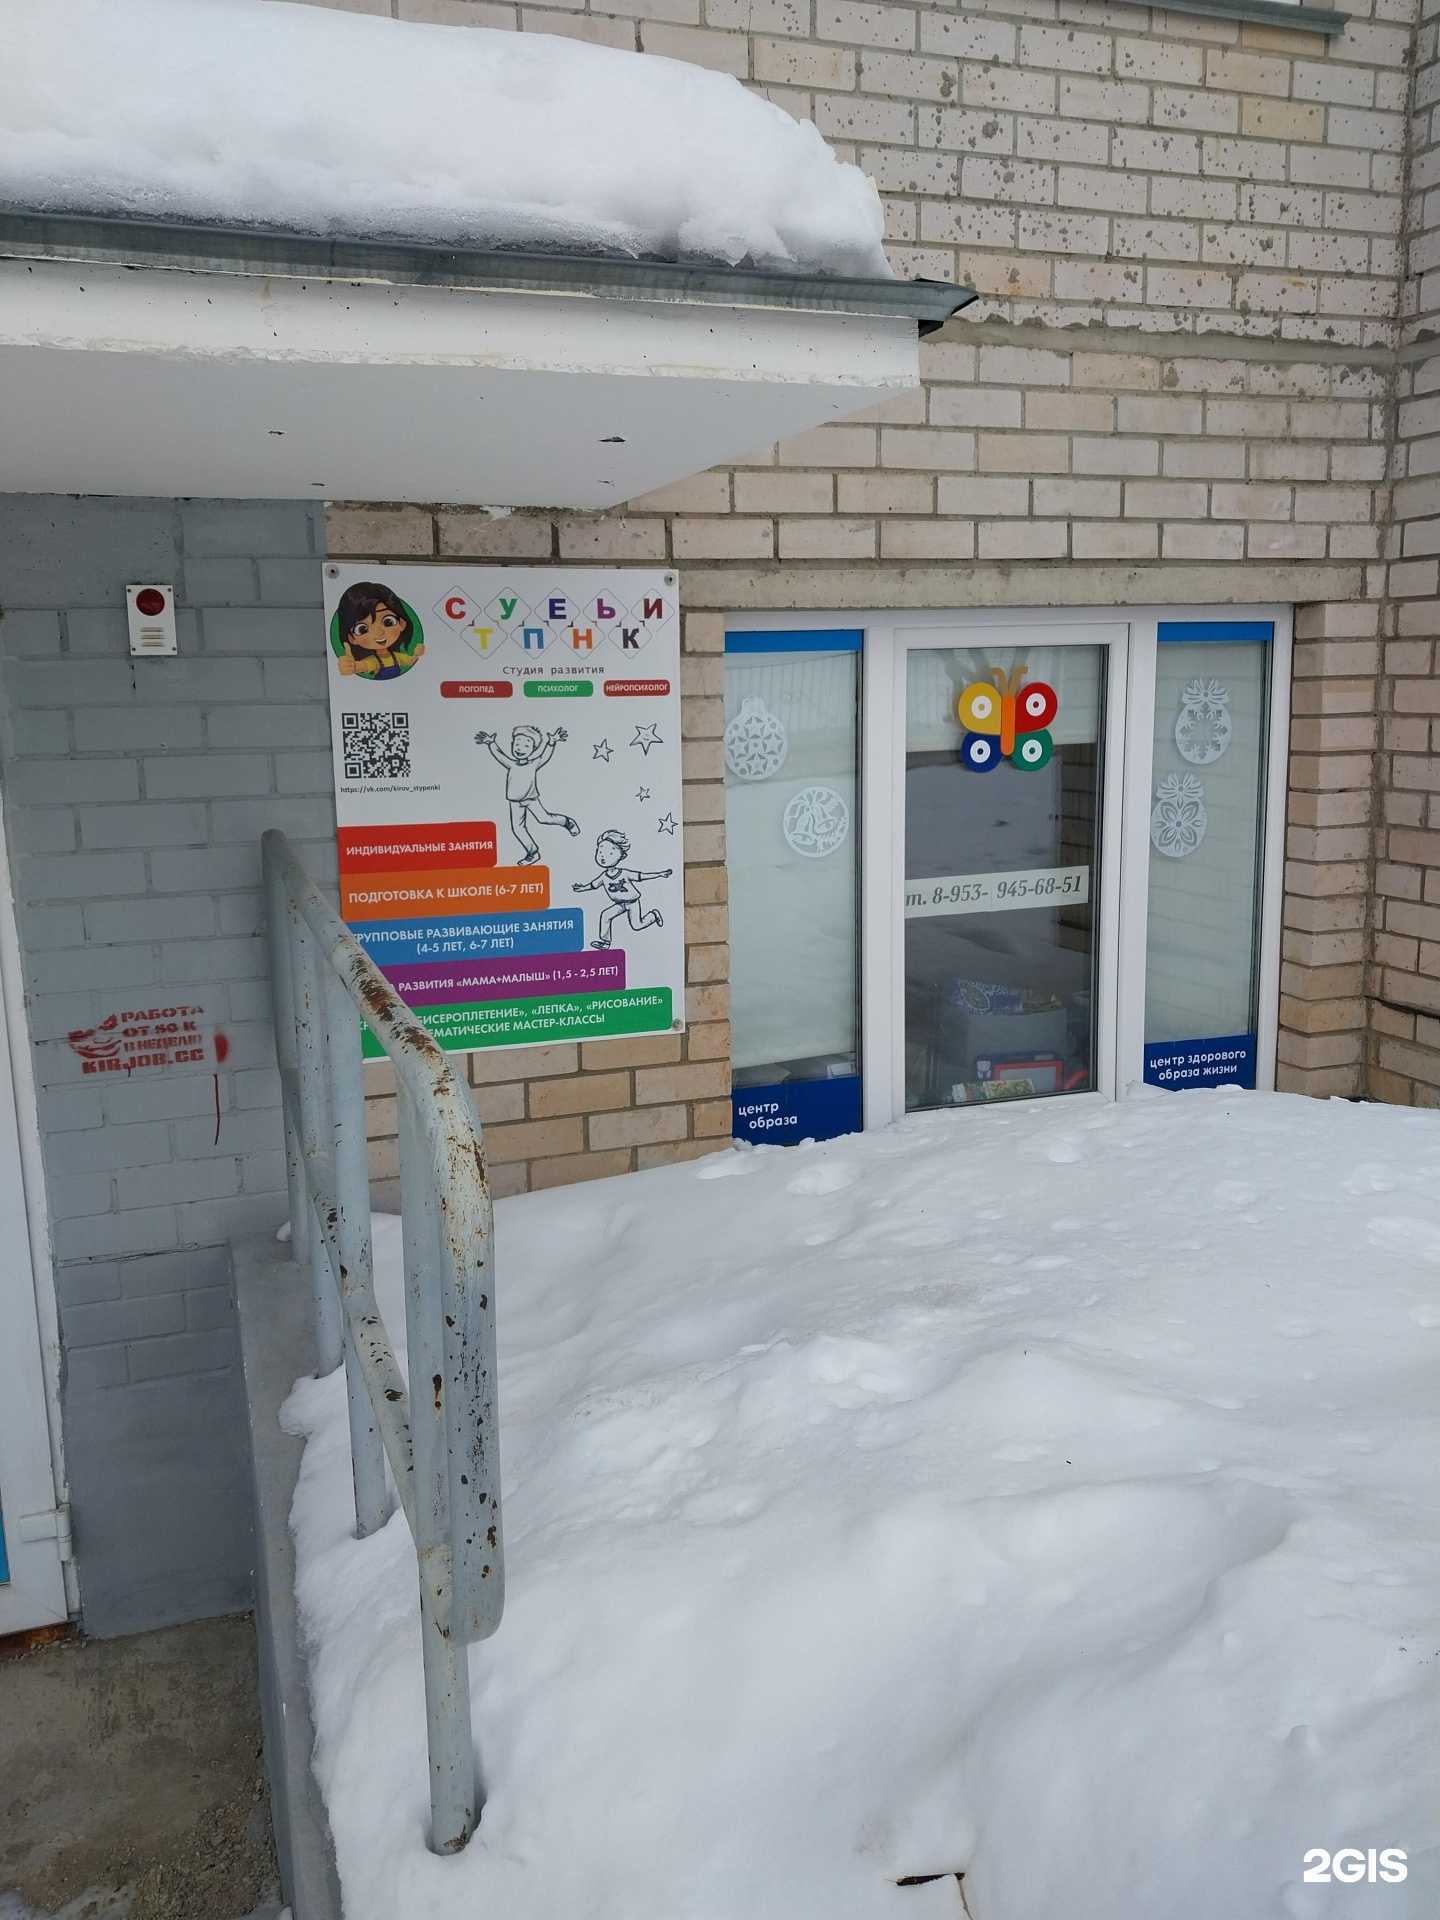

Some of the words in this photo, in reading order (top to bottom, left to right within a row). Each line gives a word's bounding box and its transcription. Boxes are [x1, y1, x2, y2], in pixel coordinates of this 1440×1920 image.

[502, 664, 544, 676] Студия
[551, 664, 605, 675] развития
[458, 685, 495, 694] ЛОГОПЕД
[537, 684, 578, 693] ПСИХОЛОГ
[606, 683, 668, 693] НЕЙРОПСИХОЛОГ
[346, 842, 446, 857] ИНДИВИДУАЛЬНЫЕ
[448, 840, 493, 851] ЗАНЯТИЯ
[349, 890, 433, 904] ПОДГОТОВКА
[436, 888, 445, 899] К
[447, 885, 492, 898] ШКОЛЕ
[495, 885, 517, 897] (6-7
[520, 883, 544, 894] ЛЕТ)
[996, 875, 1082, 899] 945-68-51
[426, 924, 520, 939] РАЗВИВАЮЩИЕ
[523, 920, 574, 932] ЗАНЯТИЯ
[416, 943, 440, 956] (4-5
[442, 941, 466, 952] ЛЕТ,
[469, 939, 488, 950] 6-7
[490, 937, 514, 949] ЛЕТ)
[398, 978, 454, 992] РАЗВИТИЯ
[456, 972, 550, 988] «МАМА+МАЛЫШ»
[552, 969, 572, 981] (1,5
[580, 968, 596, 978] 2,5
[597, 966, 618, 976] ЛЕТ)
[121, 1006, 204, 1022] РАБОТА
[531, 1002, 583, 1017] «ЛЕПКА»,
[586, 996, 663, 1011] «РИСОВАНИЕ»
[513, 1014, 605, 1031] МАСТЕР-КЛАССЫ
[123, 1026, 150, 1037] ОТ
[82, 1049, 204, 1074] KIRJOB.CC
[1150, 1056, 1184, 1069] центр
[1188, 1050, 1246, 1063] здорового
[1159, 1068, 1199, 1080] образа
[1203, 1065, 1237, 1075] жизни
[738, 1102, 779, 1117] центр
[749, 1115, 798, 1130] образа
